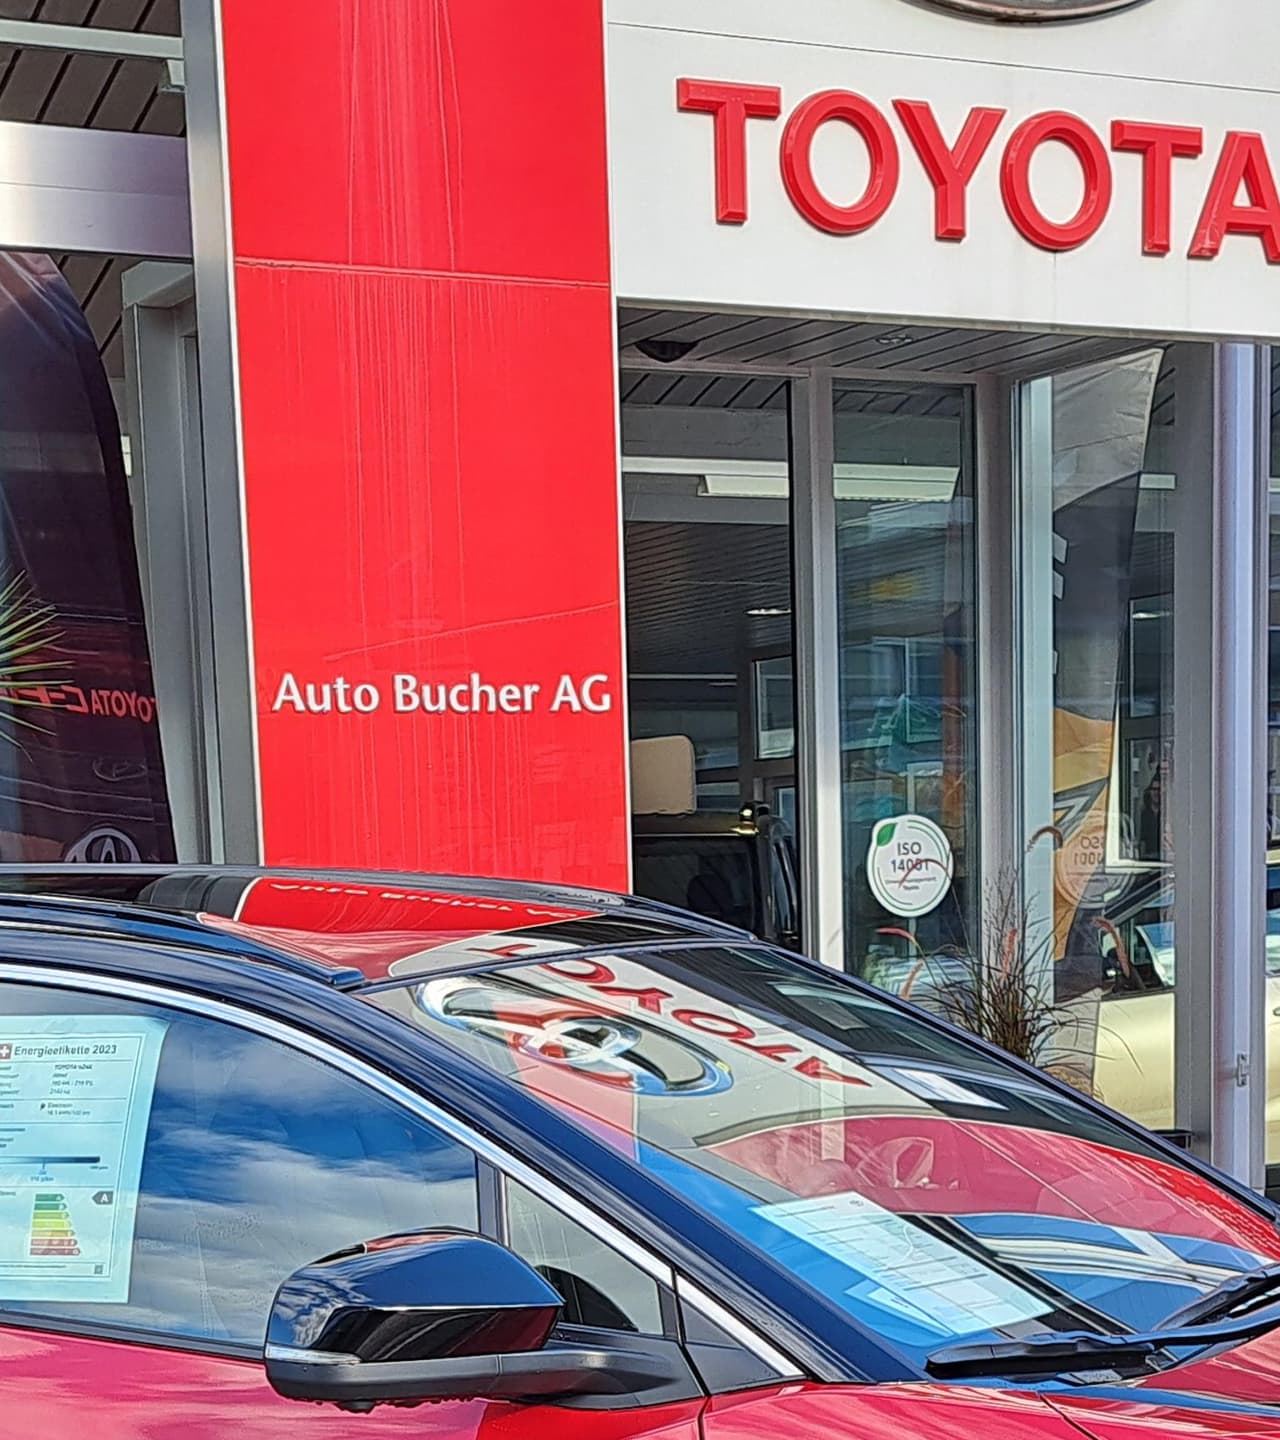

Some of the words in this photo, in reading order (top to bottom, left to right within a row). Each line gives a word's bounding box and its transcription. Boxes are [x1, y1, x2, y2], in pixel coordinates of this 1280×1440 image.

[272, 672, 380, 713] Auto
[394, 672, 540, 713] Bucher
[550, 674, 611, 712] AG
[897, 841, 922, 856] ISO
[891, 858, 929, 872] 14001
[14, 1045, 90, 1058] Energieetikette
[92, 1044, 117, 1055] 2023
[100, 1193, 109, 1203] A
